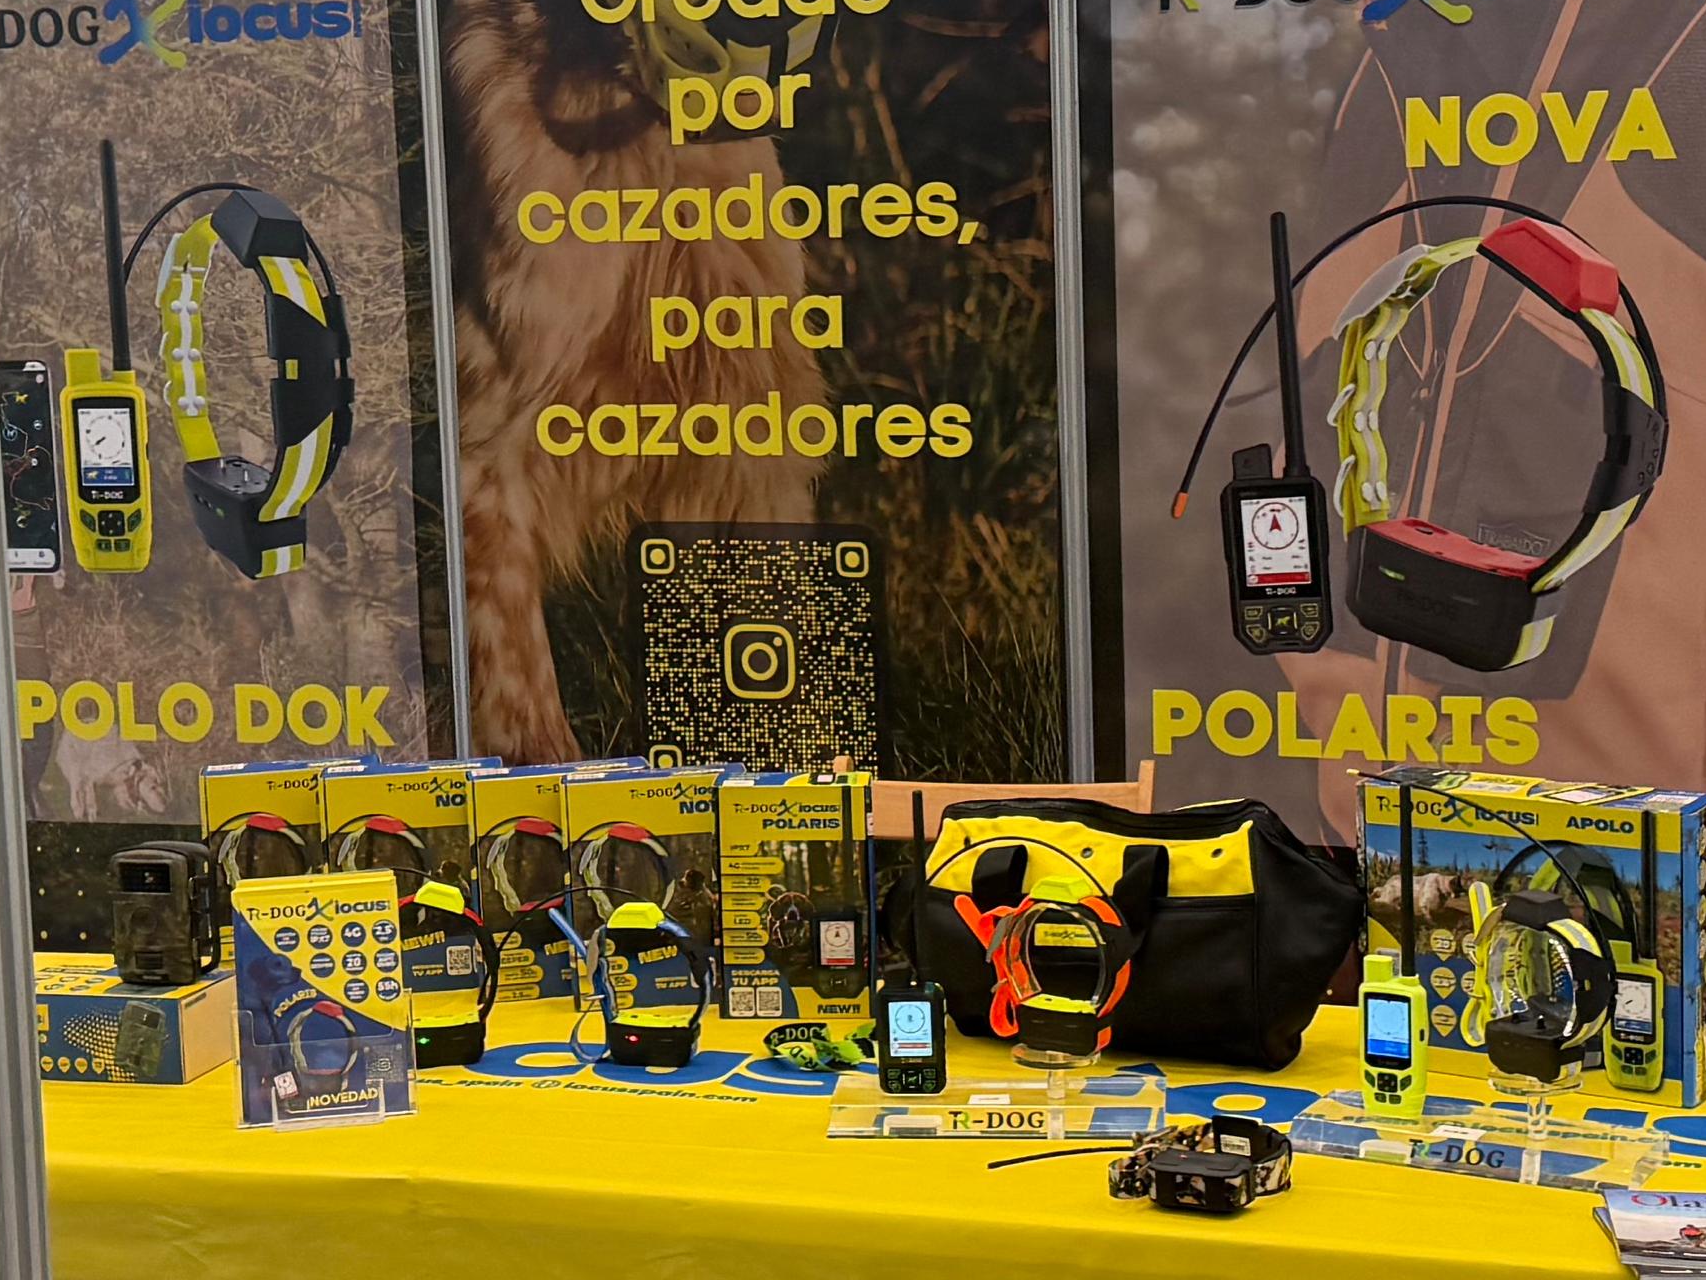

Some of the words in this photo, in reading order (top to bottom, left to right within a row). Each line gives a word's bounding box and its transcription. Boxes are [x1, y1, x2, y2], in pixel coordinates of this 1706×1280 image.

[668, 72, 811, 145] por
[1405, 86, 1678, 169] NOVA
[517, 172, 980, 245] cazadores,
[649, 294, 844, 363] para
[535, 390, 974, 458] cazadores
[234, 682, 395, 747] DOK
[1151, 688, 1541, 766] POLARIS
[762, 818, 840, 830] POLARIS
[1566, 815, 1635, 834] APOLO
[752, 977, 779, 986] APP
